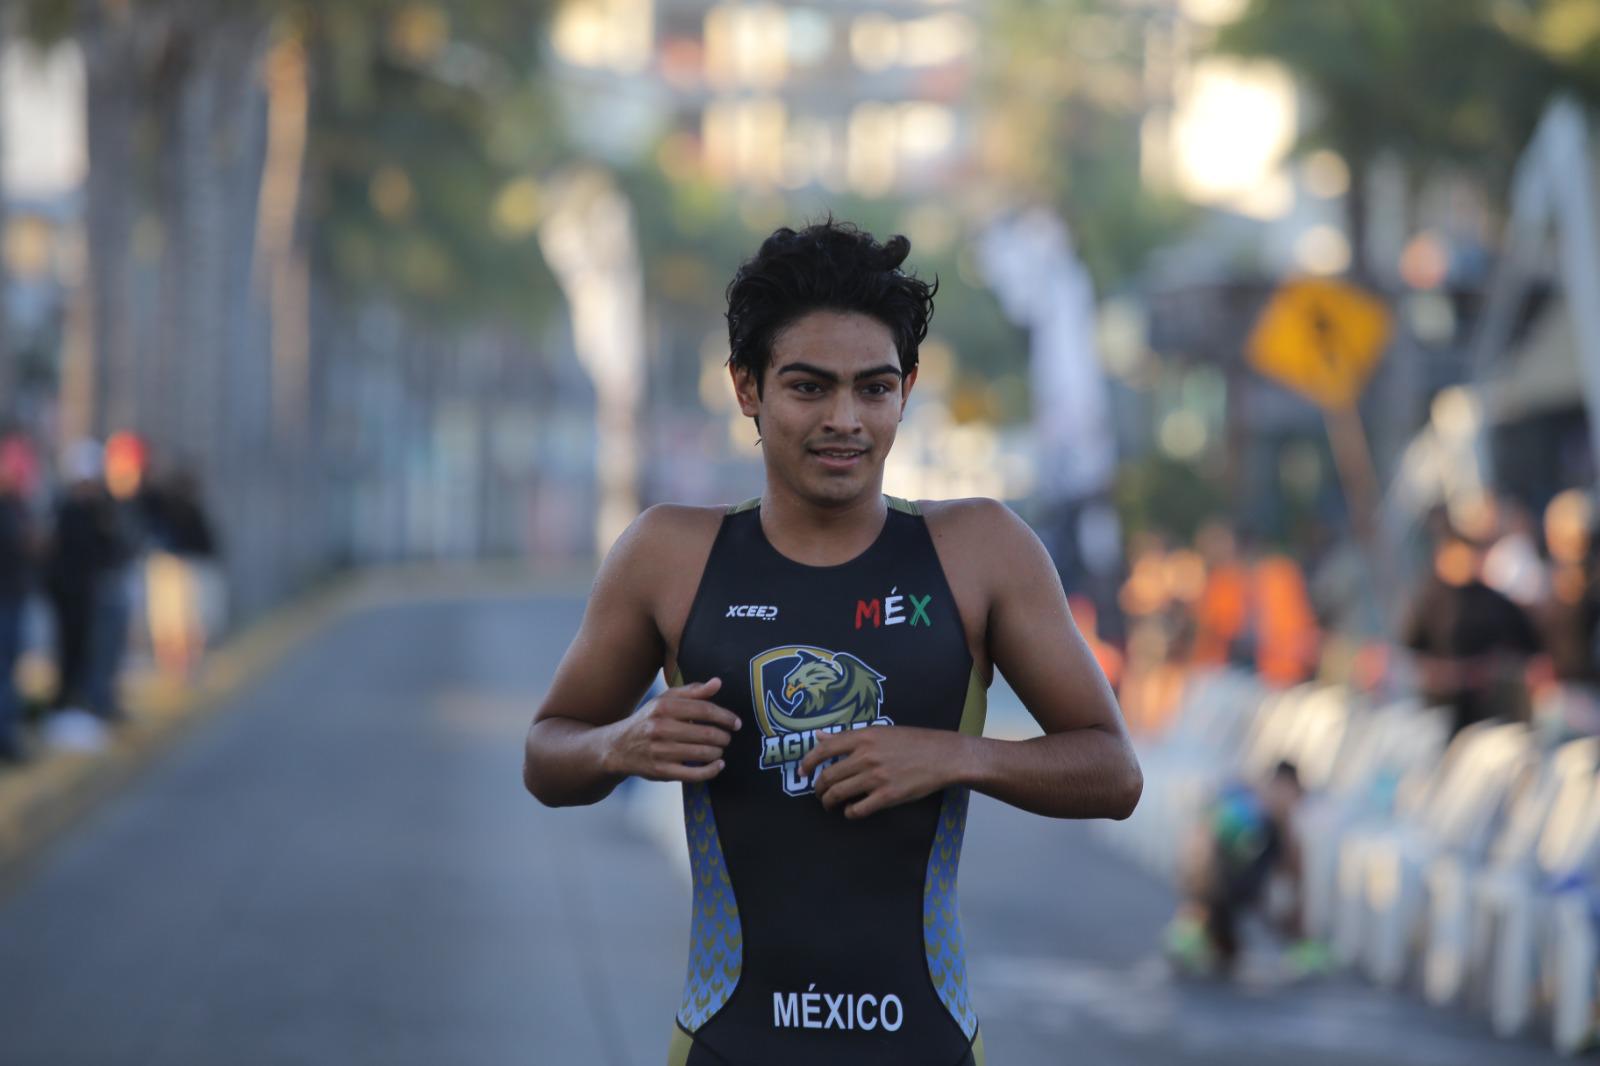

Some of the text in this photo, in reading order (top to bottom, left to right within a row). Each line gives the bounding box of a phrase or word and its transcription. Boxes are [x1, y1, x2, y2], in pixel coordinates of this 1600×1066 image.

[725, 605, 779, 620] XCEED
[855, 586, 931, 628] MÉX
[773, 982, 904, 1032] MÉXICO
